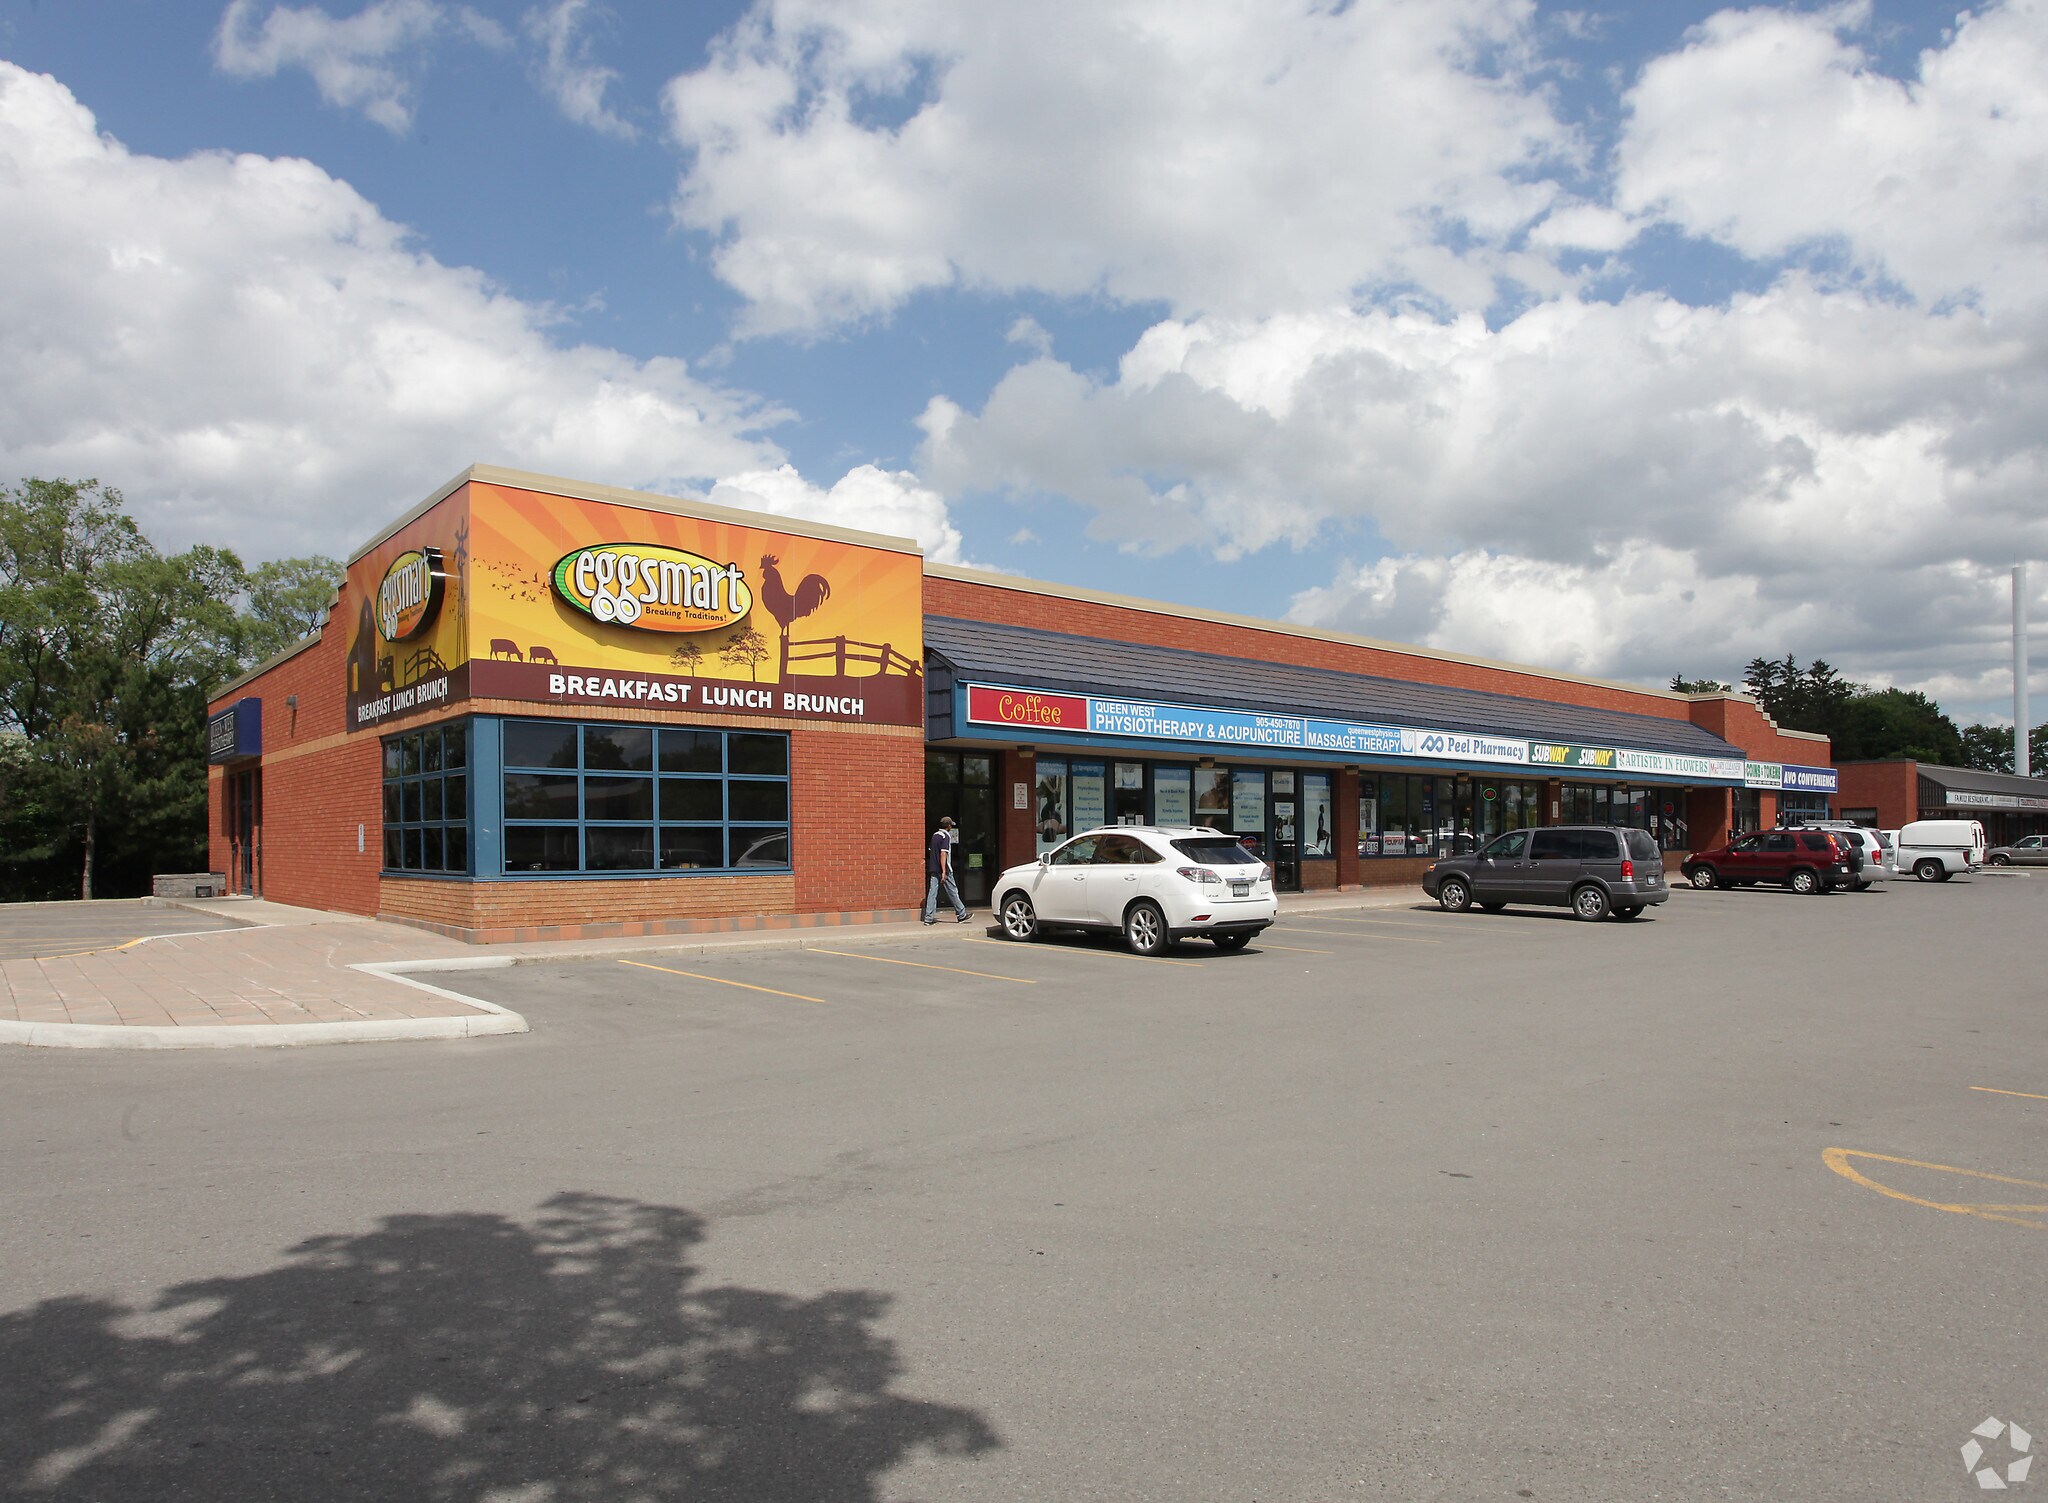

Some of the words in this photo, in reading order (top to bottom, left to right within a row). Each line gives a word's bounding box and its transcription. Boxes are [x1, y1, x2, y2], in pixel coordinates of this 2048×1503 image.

[382, 549, 429, 640] eggsmart
[575, 550, 744, 624] eggsmart
[645, 606, 682, 620] Breaking
[684, 610, 727, 622] Traditions!
[357, 697, 391, 723] BREAKFAST
[392, 689, 414, 711] LUNCH
[417, 676, 448, 703] BRUNCH
[549, 673, 692, 703] BREAKFAST
[701, 686, 772, 709] LUNCH
[783, 692, 864, 715] BRUNCH
[999, 694, 1061, 724] Coffee
[1095, 702, 1129, 715] QUEEN
[1130, 704, 1156, 717] WEST
[1095, 714, 1204, 737] PHYSIOTHERAPY
[1206, 723, 1216, 738] &
[1218, 725, 1300, 745] ACUPUNCTURE
[1256, 717, 1300, 730] 905-450-7870
[1347, 727, 1400, 739] queenwestphysio.ca
[1308, 732, 1357, 748] MASSAGE
[1358, 737, 1400, 752] THERAPY
[1448, 737, 1471, 753] Peel
[1473, 740, 1524, 759] Pharmacy
[1532, 745, 1570, 763] SUBWAY
[1578, 748, 1613, 766] SUBWAY
[1625, 754, 1662, 769] ARTISTRY
[1665, 757, 1673, 770] IN
[1675, 759, 1708, 773] FLOWERS
[1797, 772, 1836, 787] CONVENIENCE
